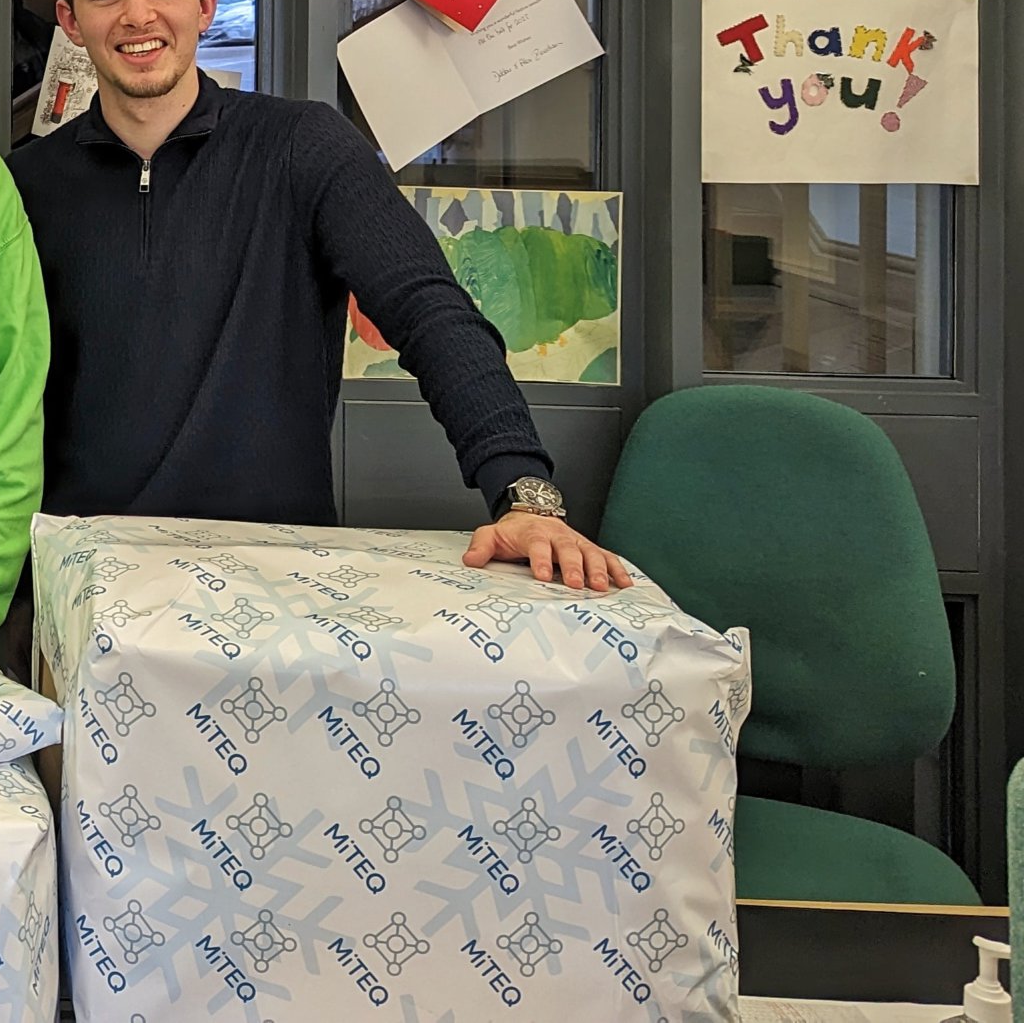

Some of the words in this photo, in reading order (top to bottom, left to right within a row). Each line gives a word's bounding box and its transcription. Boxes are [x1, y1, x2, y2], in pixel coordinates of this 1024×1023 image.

[758, 73, 928, 135] you!
[59, 548, 98, 571] MiTEQ
[166, 558, 227, 593] MiTEQ
[286, 571, 350, 601] MiTEQ
[367, 547, 426, 559] MiTEQ
[408, 569, 476, 591] MiTEQ
[177, 613, 241, 661] MiTEQ
[304, 613, 372, 661] MiTEQ
[433, 608, 505, 663] MiTEQ
[564, 603, 639, 663] MiTEQ
[78, 688, 118, 765] MiTEQ
[186, 703, 248, 776] MiTEQ
[318, 706, 381, 779] MiTEQ
[451, 708, 515, 780] MiTEQ
[586, 709, 647, 779] MiTEQ
[76, 800, 123, 878] MiTEQ
[191, 819, 253, 891] MiTEQ
[324, 823, 386, 895] MiTEQ
[457, 824, 519, 895] MiTEQ
[591, 824, 651, 893] MiTEQ
[76, 914, 126, 993] MiTEQ
[195, 934, 256, 1003] MiTEQ
[327, 937, 389, 1006] MiTEQ
[460, 939, 521, 1007] MiTEQ
[593, 937, 651, 1004] MiTEQ
